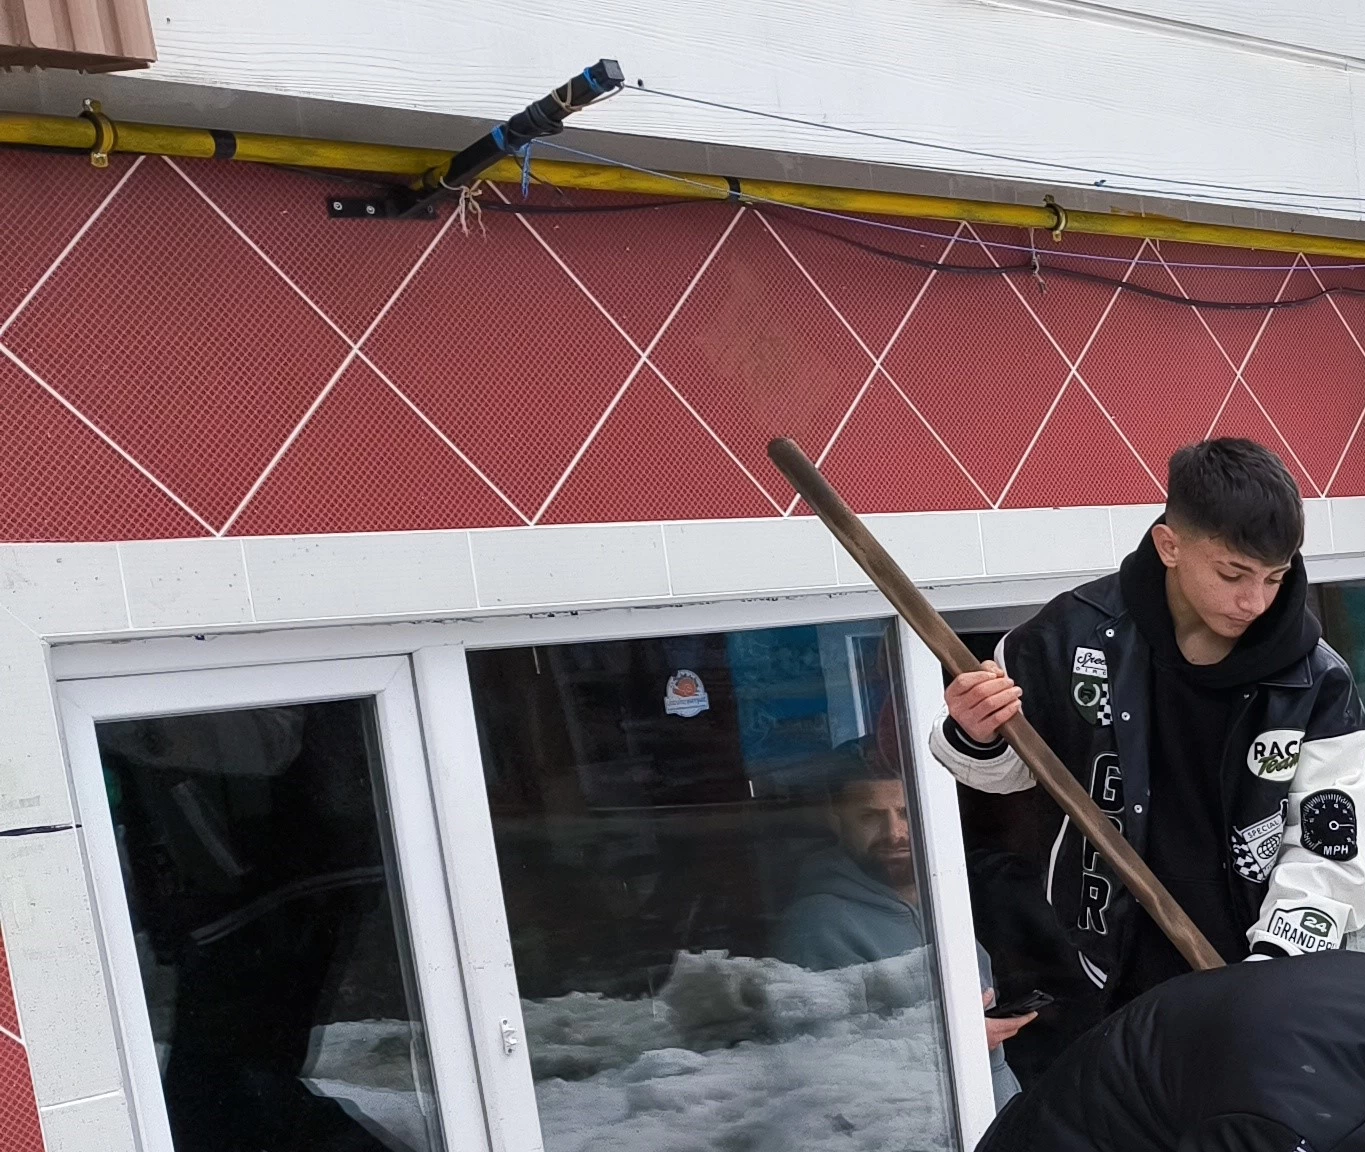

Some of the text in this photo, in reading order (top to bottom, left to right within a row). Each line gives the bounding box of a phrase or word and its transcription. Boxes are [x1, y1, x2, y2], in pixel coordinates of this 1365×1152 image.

[1253, 740, 1299, 761] RAC
[1246, 818, 1280, 839] SPECIAL
[1323, 844, 1349, 856] MPH
[1272, 916, 1336, 952] GRAND PR
[1303, 916, 1327, 933] 24
